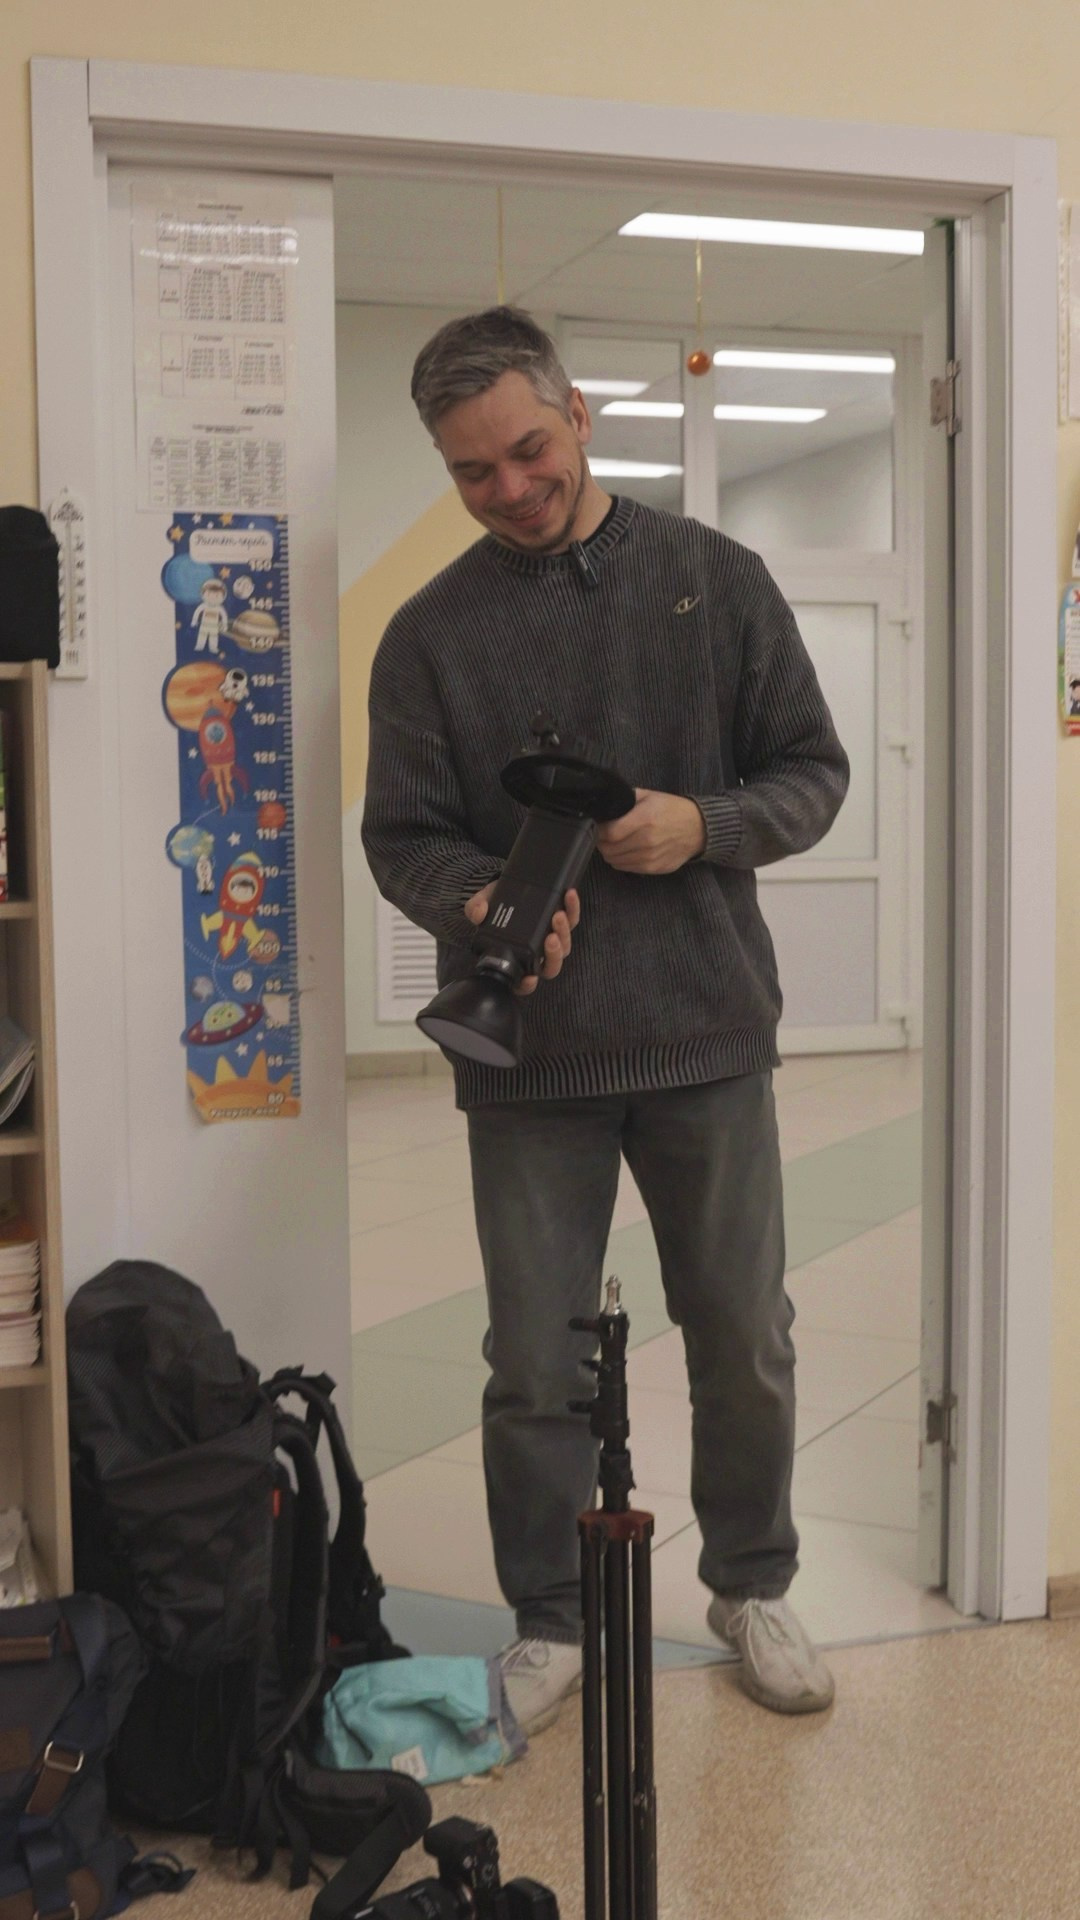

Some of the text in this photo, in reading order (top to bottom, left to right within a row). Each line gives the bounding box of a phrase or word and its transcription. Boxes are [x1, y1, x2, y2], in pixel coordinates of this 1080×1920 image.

[249, 560, 272, 572] 150
[249, 598, 273, 610] 145
[250, 637, 274, 648] 140
[252, 674, 275, 687] 135
[252, 713, 276, 725] 130
[253, 751, 277, 763] 125
[254, 790, 277, 802] 120
[256, 828, 278, 840] 115
[257, 867, 279, 878] 110
[257, 904, 280, 916] 105
[257, 942, 280, 953] 100
